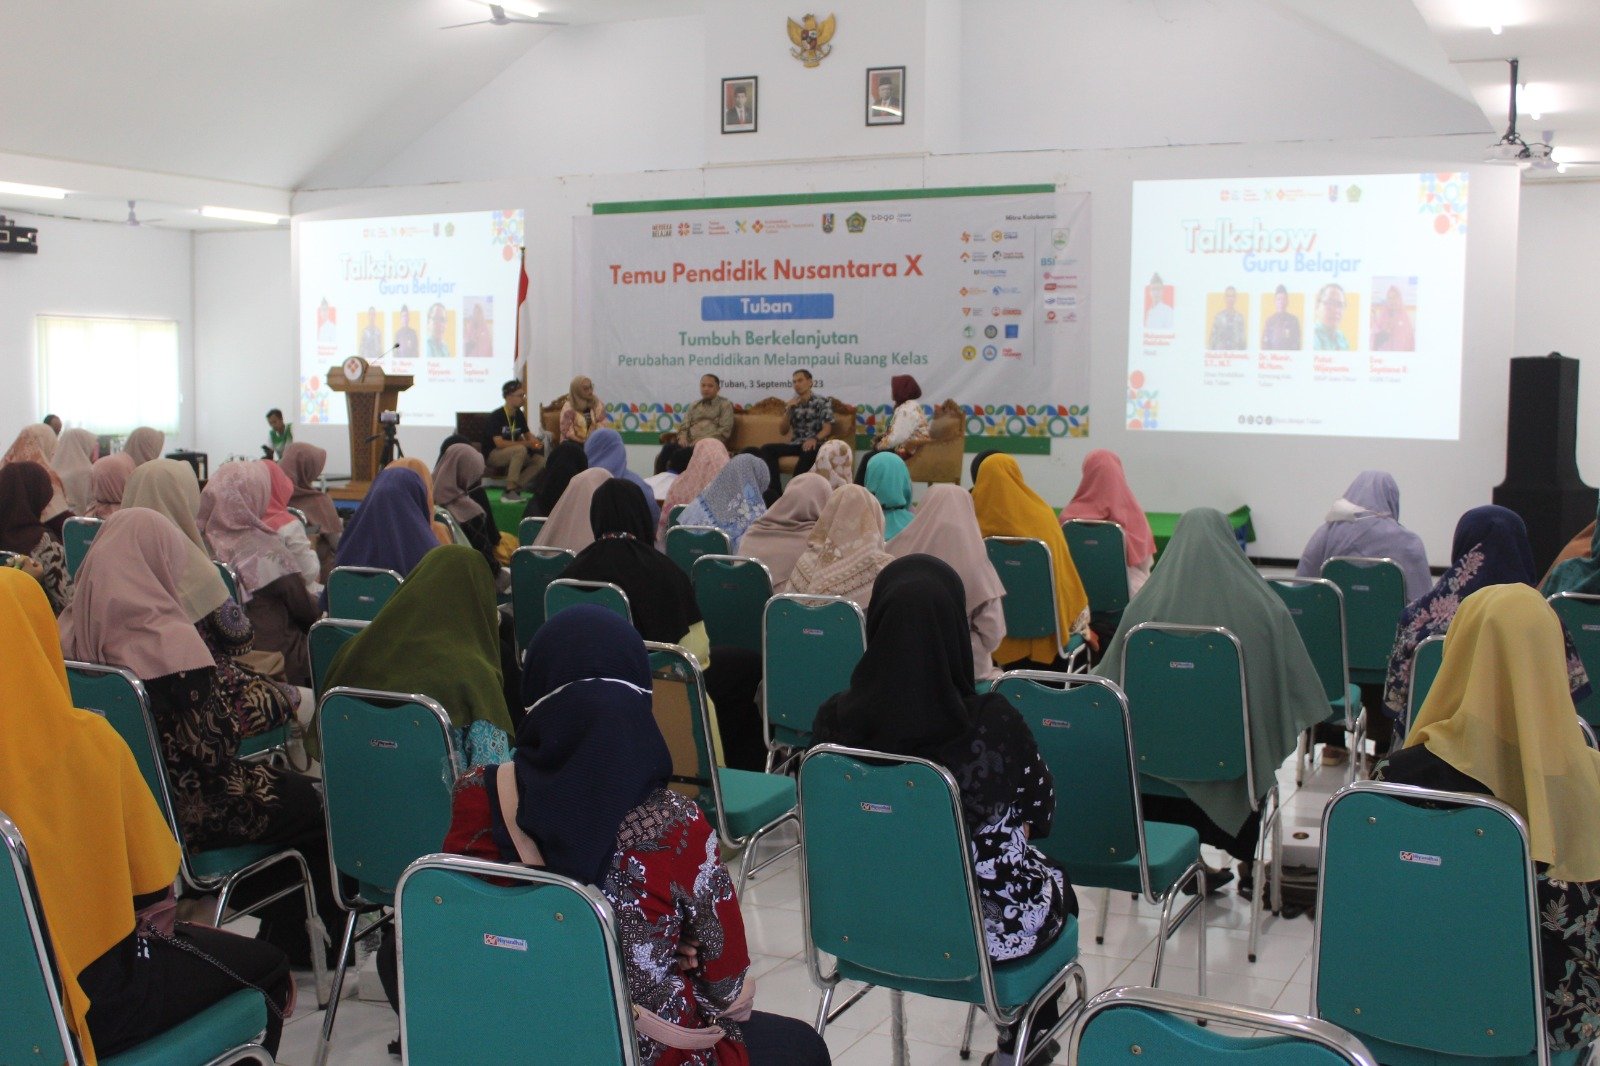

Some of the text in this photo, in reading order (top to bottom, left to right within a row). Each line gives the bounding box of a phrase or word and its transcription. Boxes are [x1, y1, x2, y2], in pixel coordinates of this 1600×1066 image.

[1181, 217, 1317, 254] Talkshow
[340, 250, 427, 281] Talkshow
[610, 254, 922, 284] Temu Pendidik Nusantara X
[1242, 251, 1361, 278] Guru Belajar
[379, 276, 456, 298] Guru Belajar
[740, 297, 792, 313] Tuban
[679, 329, 859, 350] Tumbuh Berkelanjutan
[618, 350, 928, 368] Perubahan Pendidikan Melampaui Ruang Kelas
[720, 380, 747, 390] Tuban,
[749, 380, 755, 388] 3
[756, 380, 793, 390] Septemb
